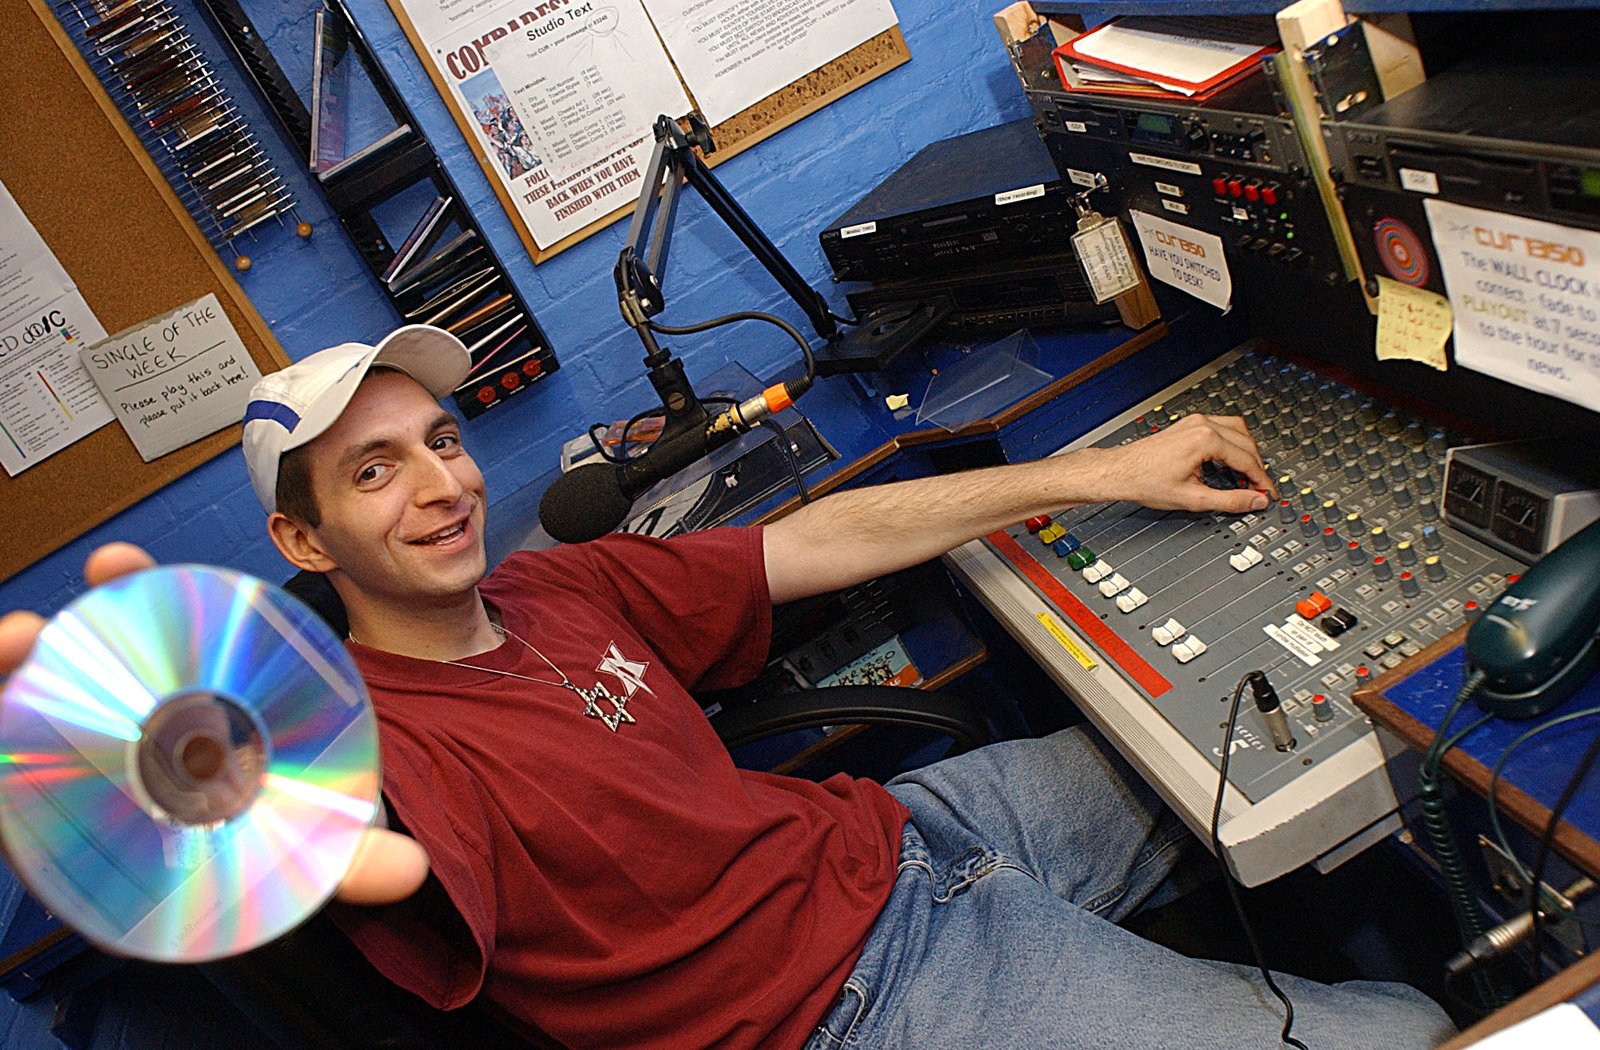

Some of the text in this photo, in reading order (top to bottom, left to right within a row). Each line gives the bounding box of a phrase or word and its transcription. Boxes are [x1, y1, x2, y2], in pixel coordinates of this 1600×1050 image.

[526, 2, 593, 41] Studio Text
[565, 25, 588, 40] message
[524, 168, 550, 188] FOLL
[545, 154, 636, 210] BACK WHEN YOU HAVE
[523, 184, 551, 205] THESE
[554, 168, 641, 221] FINISHED WITH THEM
[1148, 245, 1221, 282] HAVE YOU SWITCHED
[1171, 266, 1185, 281] TO
[1461, 250, 1491, 272] The
[1491, 260, 1532, 283] WALL
[1535, 269, 1590, 295] CLOCK
[1462, 294, 1528, 322] PLAYOUT
[1577, 305, 1597, 323] to
[91, 336, 155, 370] SINGLE
[162, 321, 179, 343] OF
[182, 306, 216, 327] THE
[1479, 321, 1496, 338] to
[1497, 326, 1523, 345] the
[1525, 333, 1559, 354] hour
[125, 347, 186, 379] WEEK
[120, 354, 236, 414] Please play this and
[139, 366, 249, 428] please put it back here!
[1304, 625, 1317, 634] NOT
[1313, 632, 1328, 642] touch
[1234, 725, 1265, 750] series
